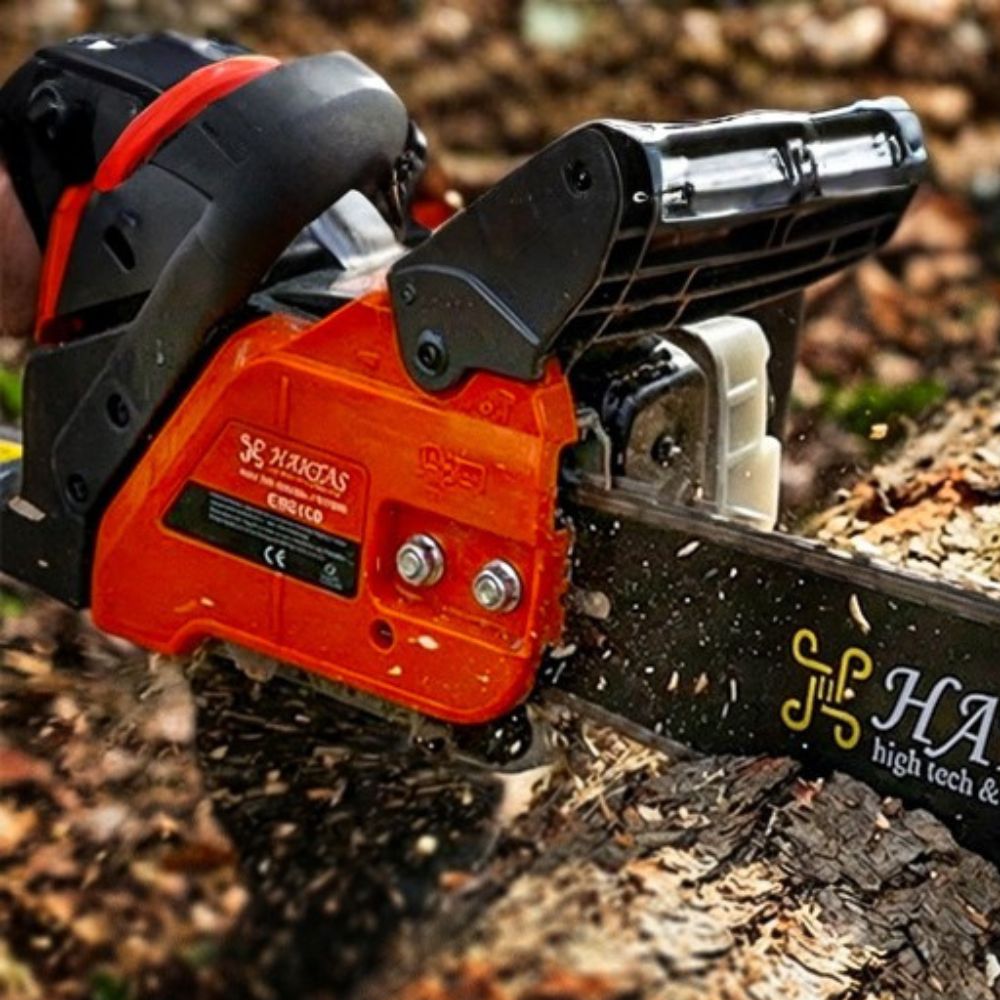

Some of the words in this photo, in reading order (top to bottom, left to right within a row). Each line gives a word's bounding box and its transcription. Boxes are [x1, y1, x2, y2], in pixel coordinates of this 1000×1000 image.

[263, 545, 287, 569] CE
[872, 736, 921, 777] high
[927, 762, 974, 796] tech
[978, 777, 999, 805] &
